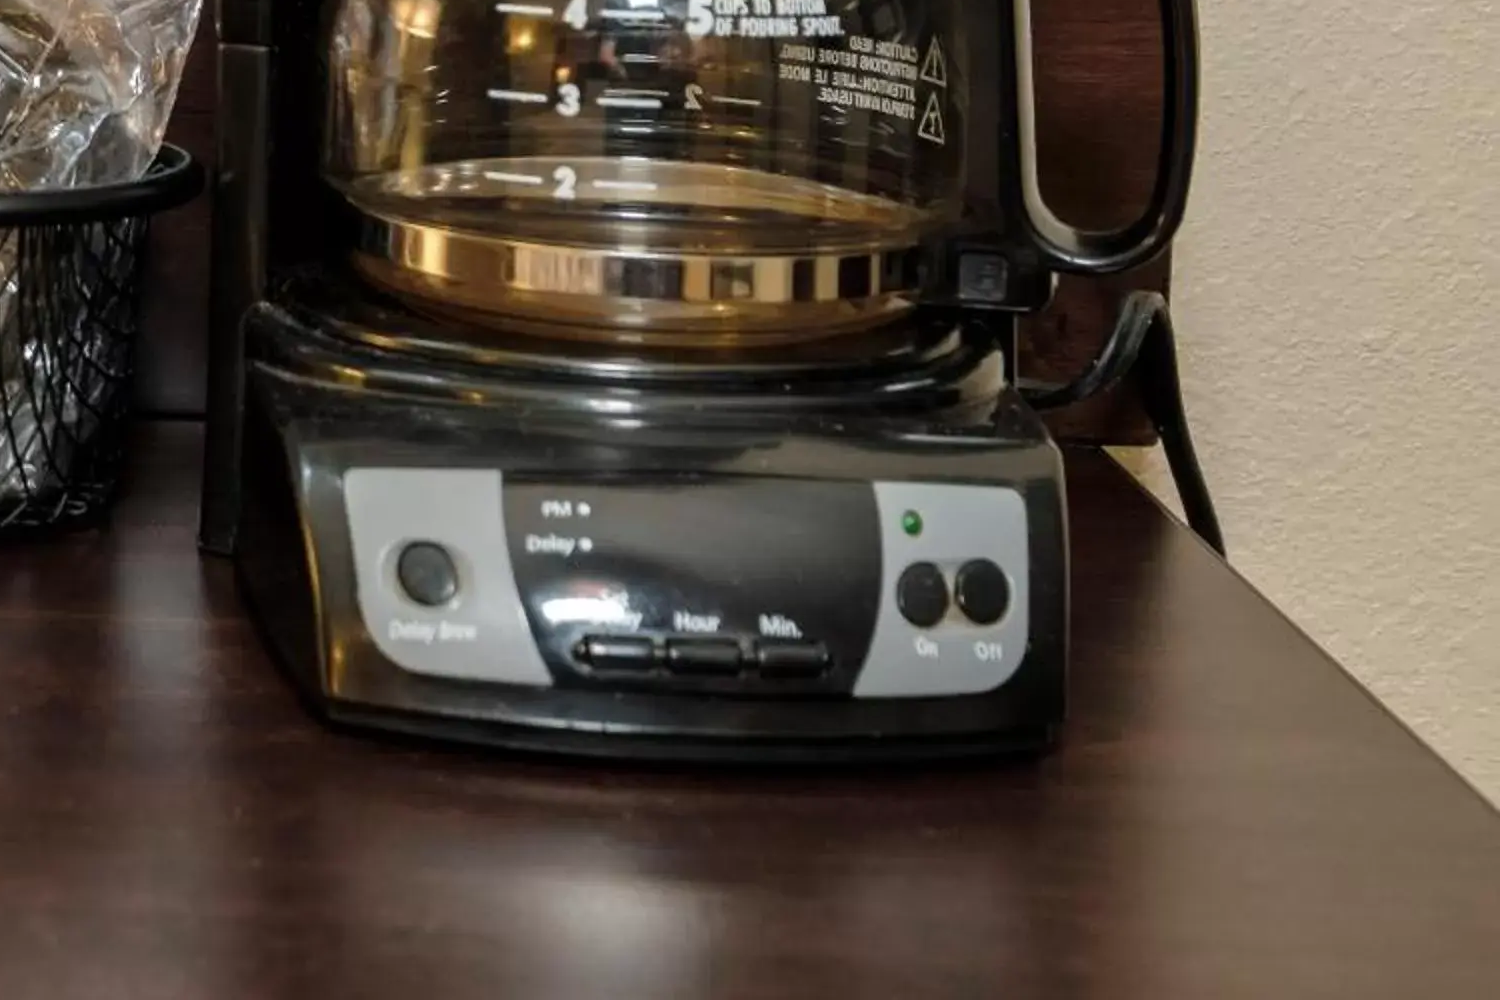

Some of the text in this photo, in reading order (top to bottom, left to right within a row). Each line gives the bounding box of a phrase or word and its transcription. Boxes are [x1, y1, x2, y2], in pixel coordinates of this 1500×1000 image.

[715, 17, 734, 37] OF
[740, 17, 799, 37] POURING
[555, 83, 581, 117] 3
[552, 166, 577, 199] 2
[541, 501, 572, 517] PM
[525, 533, 575, 557] Delay
[673, 610, 721, 632] Hour
[758, 613, 803, 638] Min.
[914, 636, 939, 657] On
[974, 641, 1003, 661] Off
